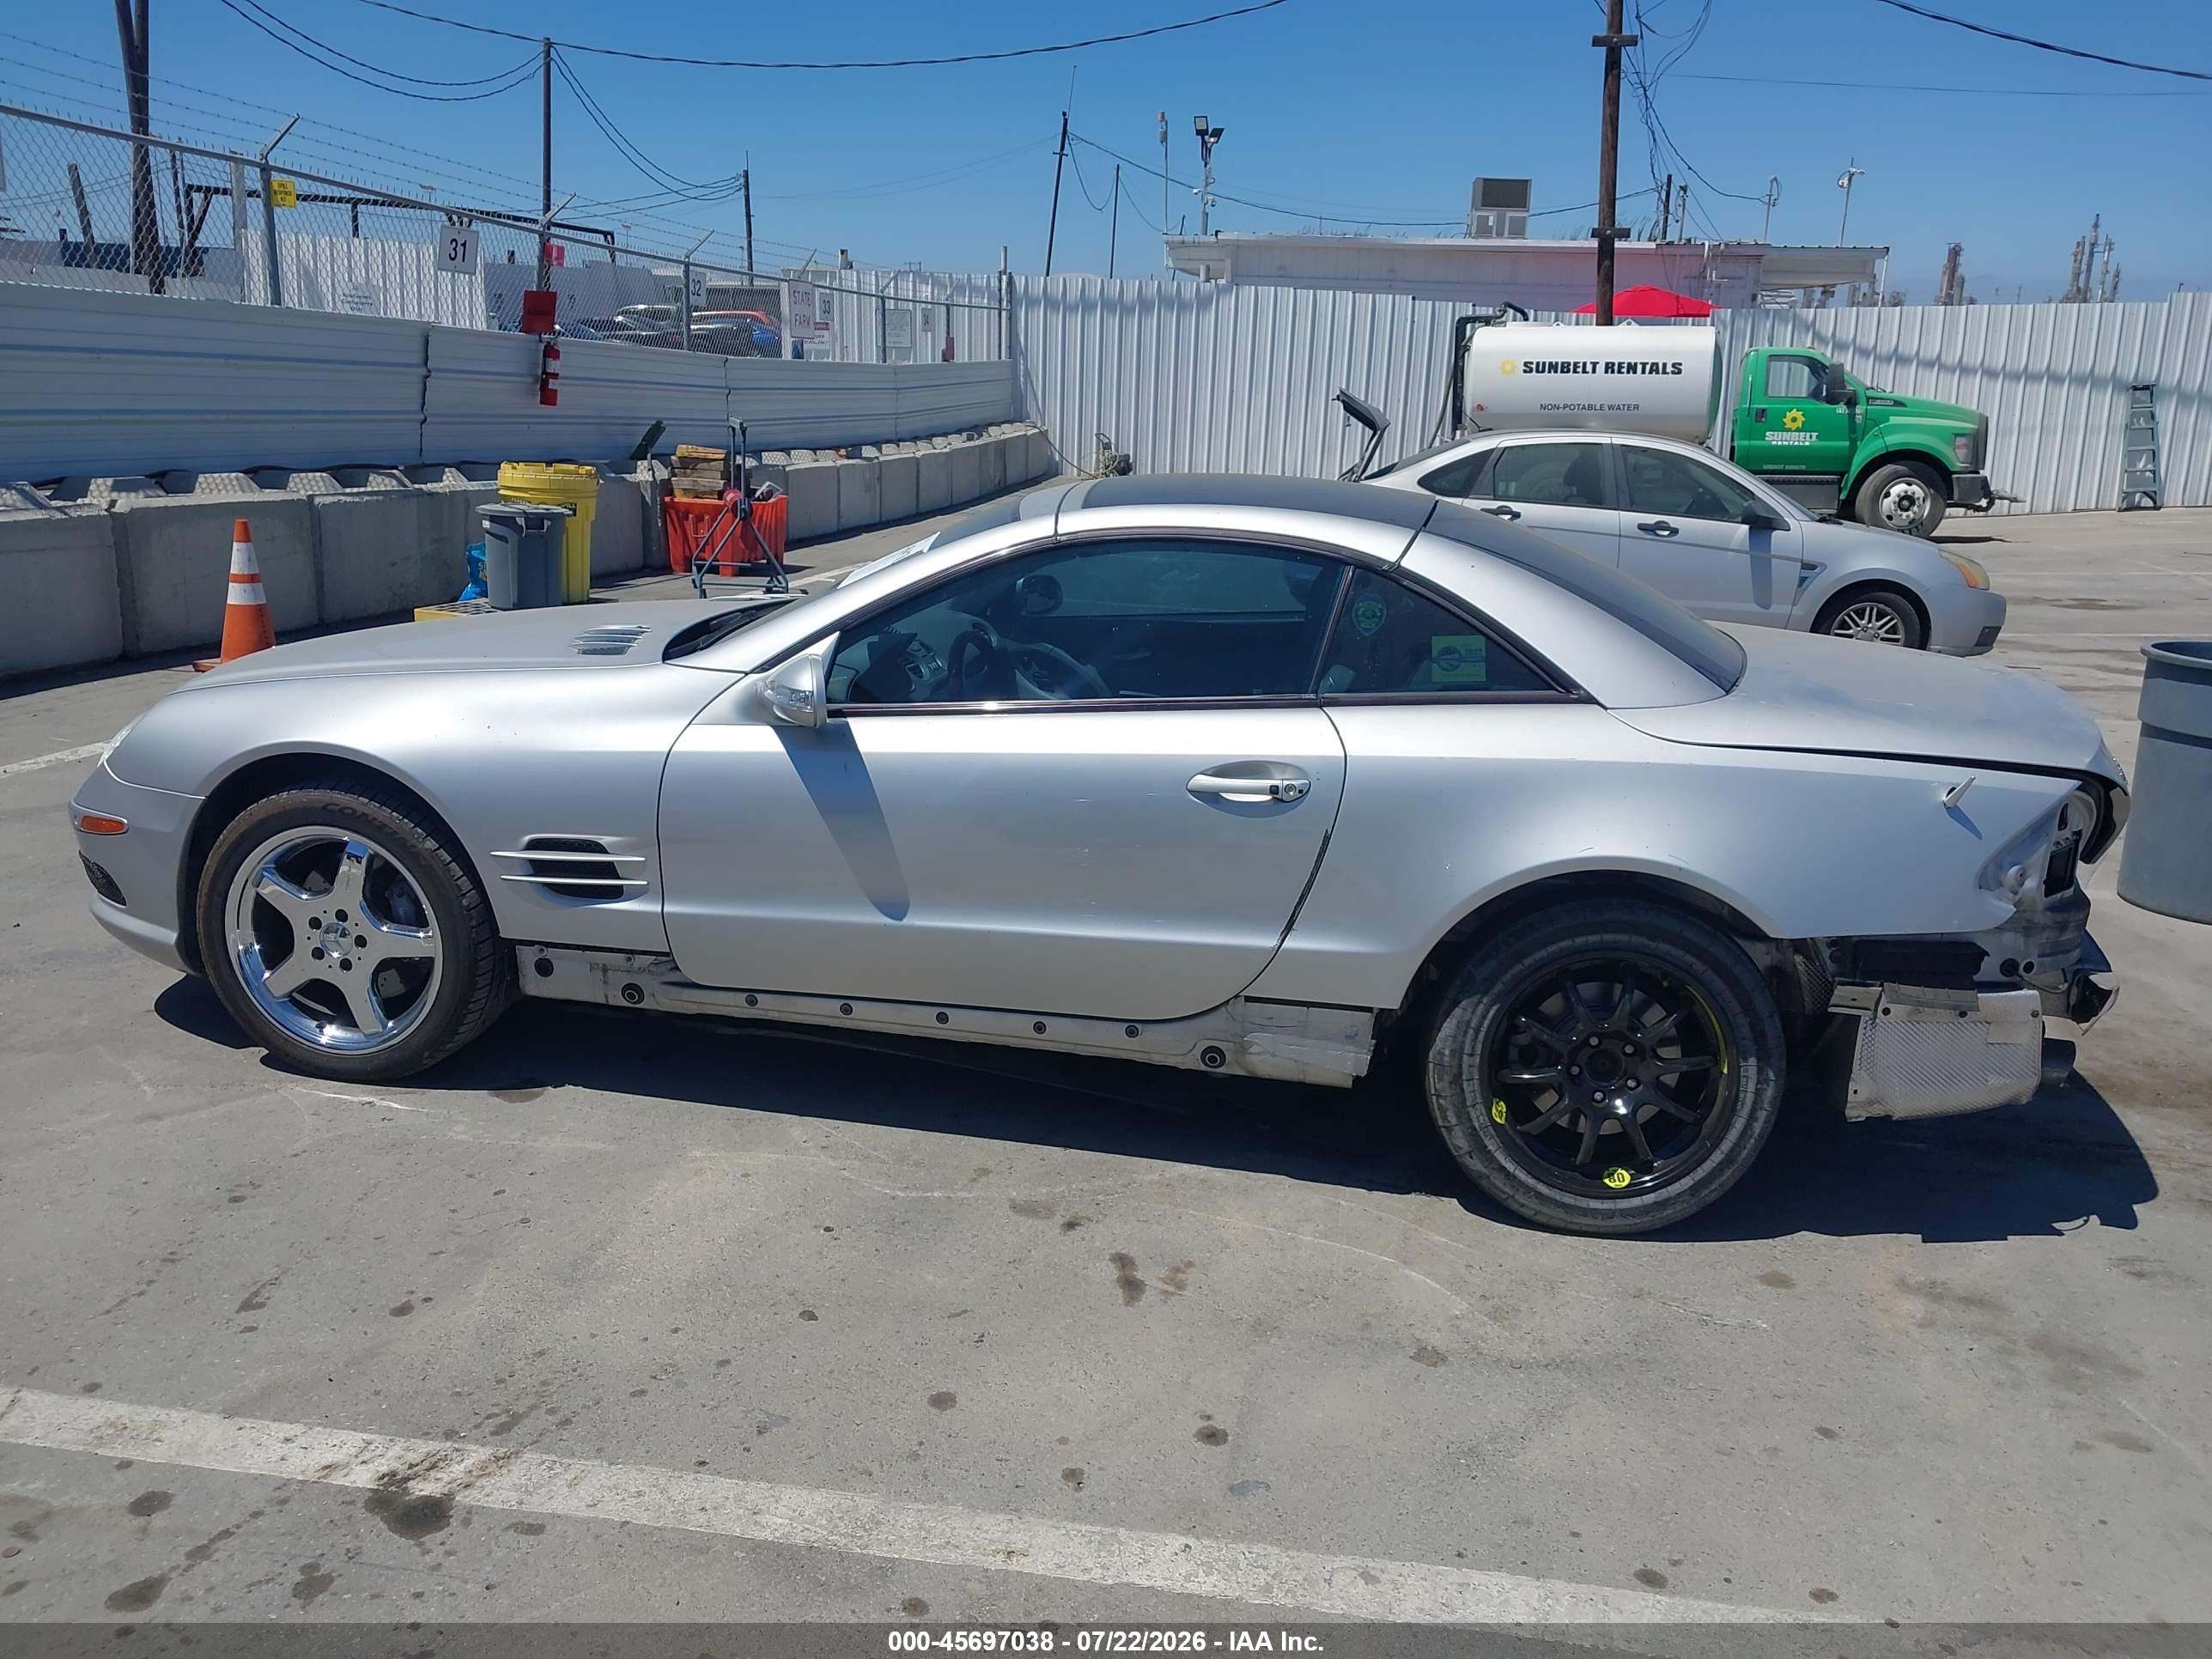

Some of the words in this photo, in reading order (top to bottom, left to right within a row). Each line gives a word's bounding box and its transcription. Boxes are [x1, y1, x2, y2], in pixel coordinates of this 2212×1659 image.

[448, 238, 467, 263] 31
[690, 278, 702, 297] 32
[793, 289, 811, 307] STATE
[823, 299, 830, 314] 33
[794, 313, 811, 328] FARM
[1522, 361, 1600, 374] SUNBELT
[1603, 362, 1683, 375] RENTALS
[1539, 403, 1605, 411] NON-POTABLE
[1607, 404, 1640, 412] WATER
[1765, 431, 1819, 441] SUNBELT
